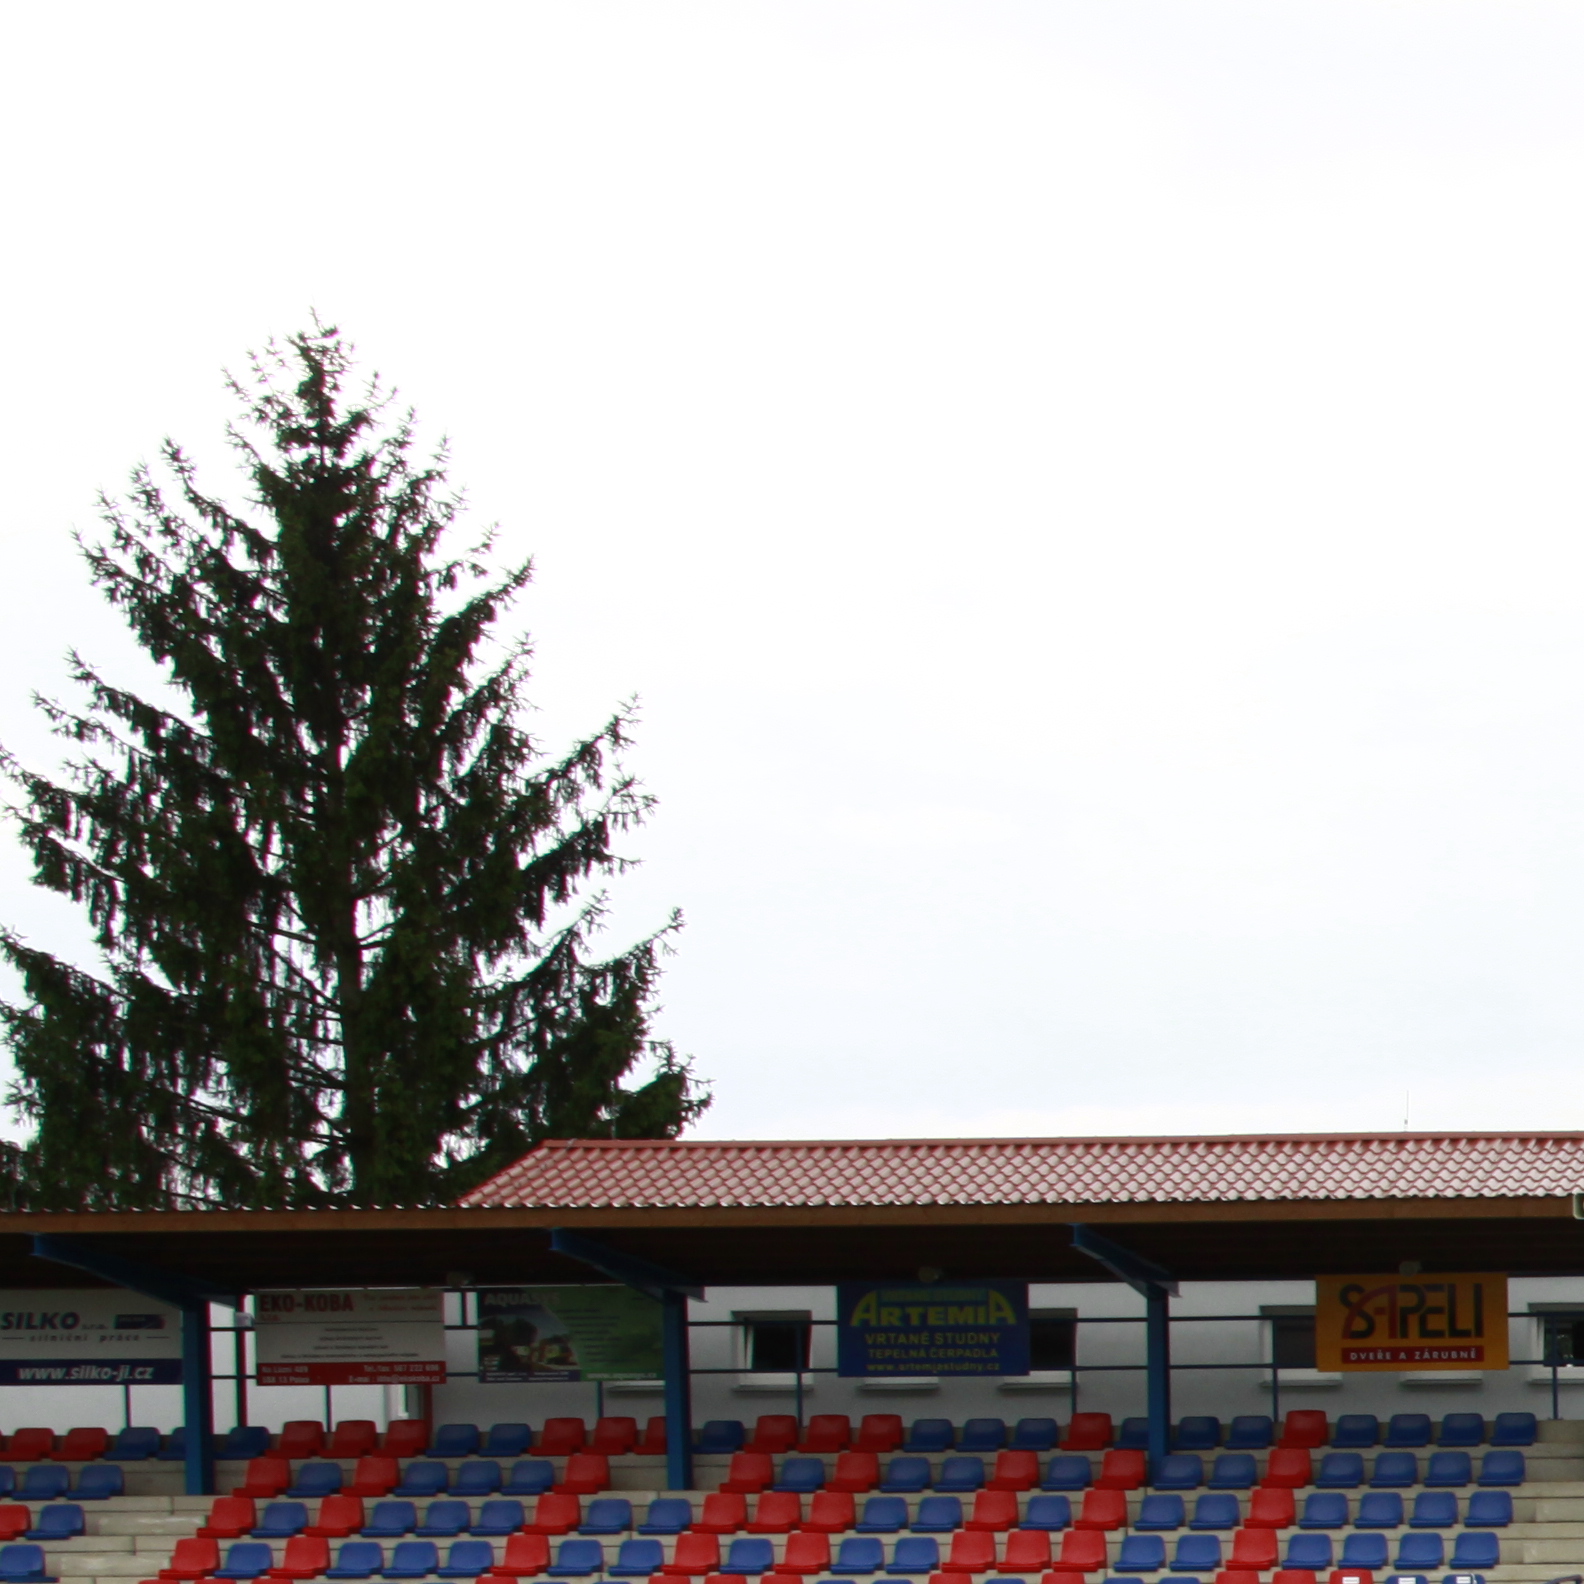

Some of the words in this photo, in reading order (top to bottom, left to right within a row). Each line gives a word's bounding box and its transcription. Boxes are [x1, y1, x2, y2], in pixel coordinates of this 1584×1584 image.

[260, 1294, 354, 1312] EKO-KOBA
[851, 1288, 1017, 1326] ARTEMIA
[1340, 1283, 1484, 1339] SAPELI
[1, 1312, 80, 1330] SILKO
[100, 1334, 140, 1343] práce
[865, 1331, 930, 1345] VRTANÉ
[934, 1332, 1001, 1345] STUDNY
[868, 1348, 926, 1359] TEPELNÁ
[928, 1347, 998, 1358] ČERPADLA
[1350, 1350, 1391, 1360] DVEŘE
[1398, 1351, 1407, 1360] A
[1414, 1348, 1477, 1360] ZÁRUBNĚ
[18, 1365, 155, 1381] www.silko-ji.cz
